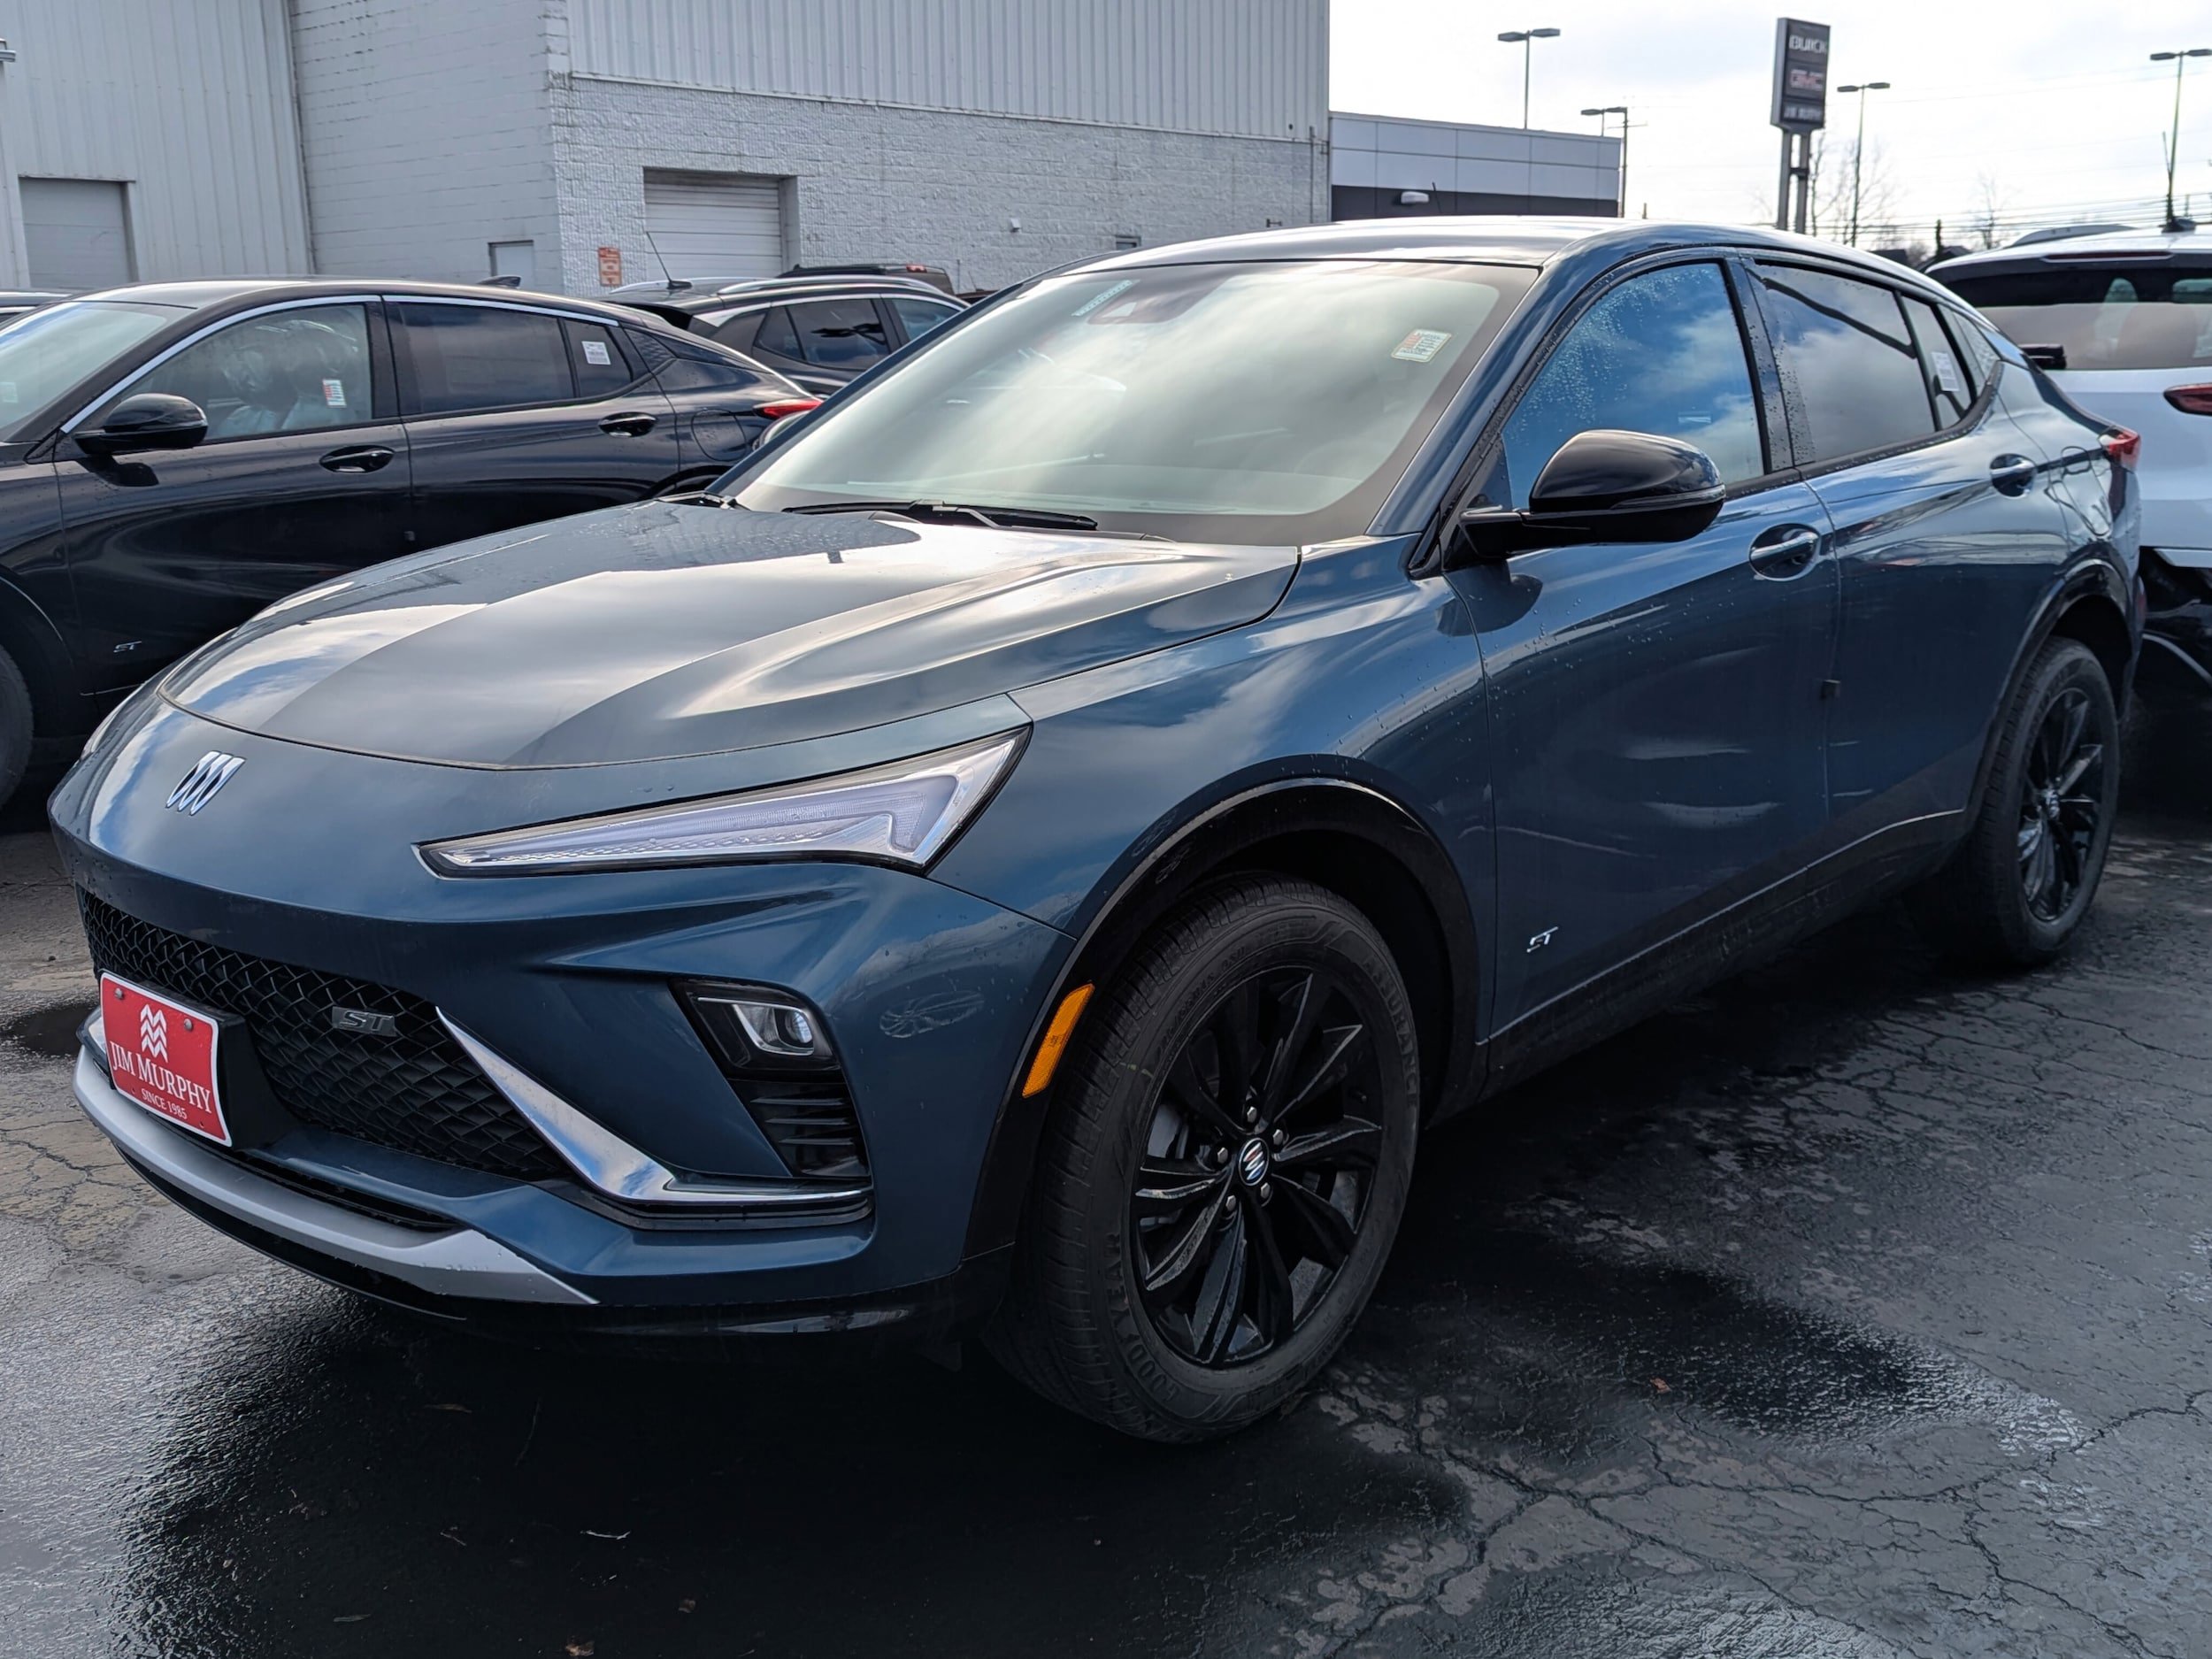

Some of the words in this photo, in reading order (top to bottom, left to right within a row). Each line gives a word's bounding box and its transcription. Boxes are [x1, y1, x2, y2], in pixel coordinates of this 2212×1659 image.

[1526, 926, 1559, 953] ST
[340, 1010, 393, 1031] ST
[110, 1041, 135, 1076] JIM
[136, 1054, 212, 1113] MURPHY
[141, 1088, 165, 1110] SINCE
[167, 1101, 188, 1120] 1985
